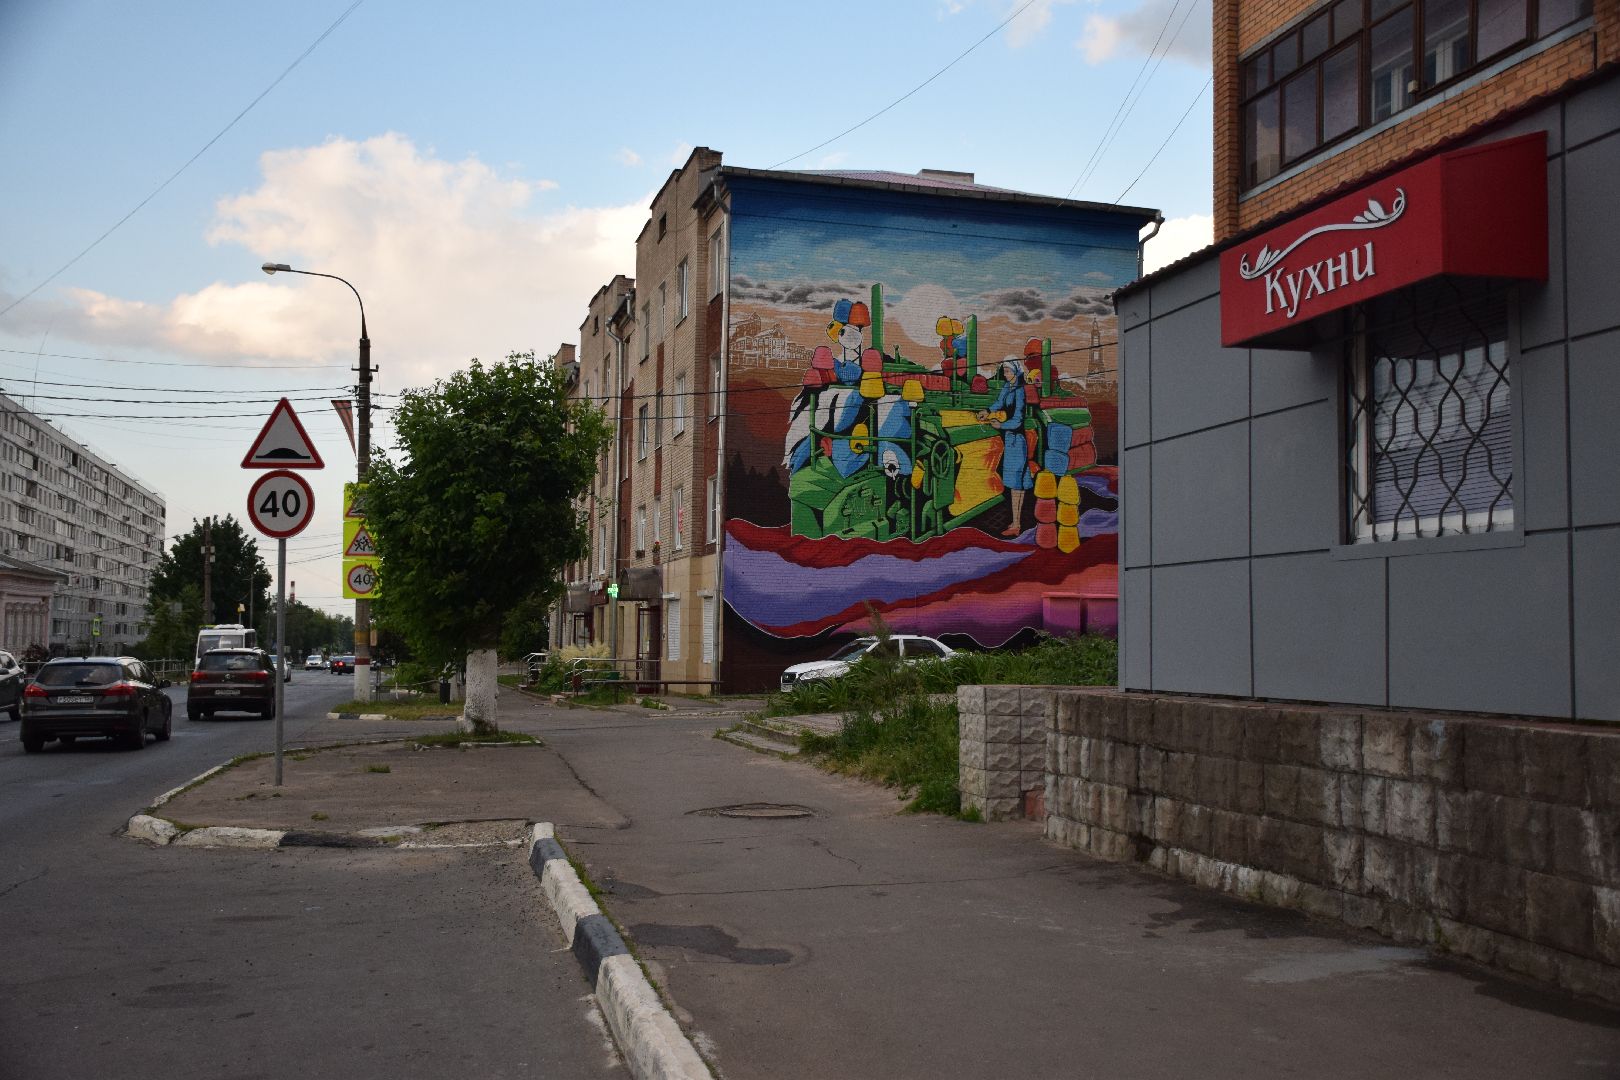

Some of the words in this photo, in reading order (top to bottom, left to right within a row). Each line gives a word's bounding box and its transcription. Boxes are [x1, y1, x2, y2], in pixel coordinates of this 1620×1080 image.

[1264, 241, 1376, 319] Кухни
[259, 489, 301, 518] 40
[353, 573, 371, 586] 40
